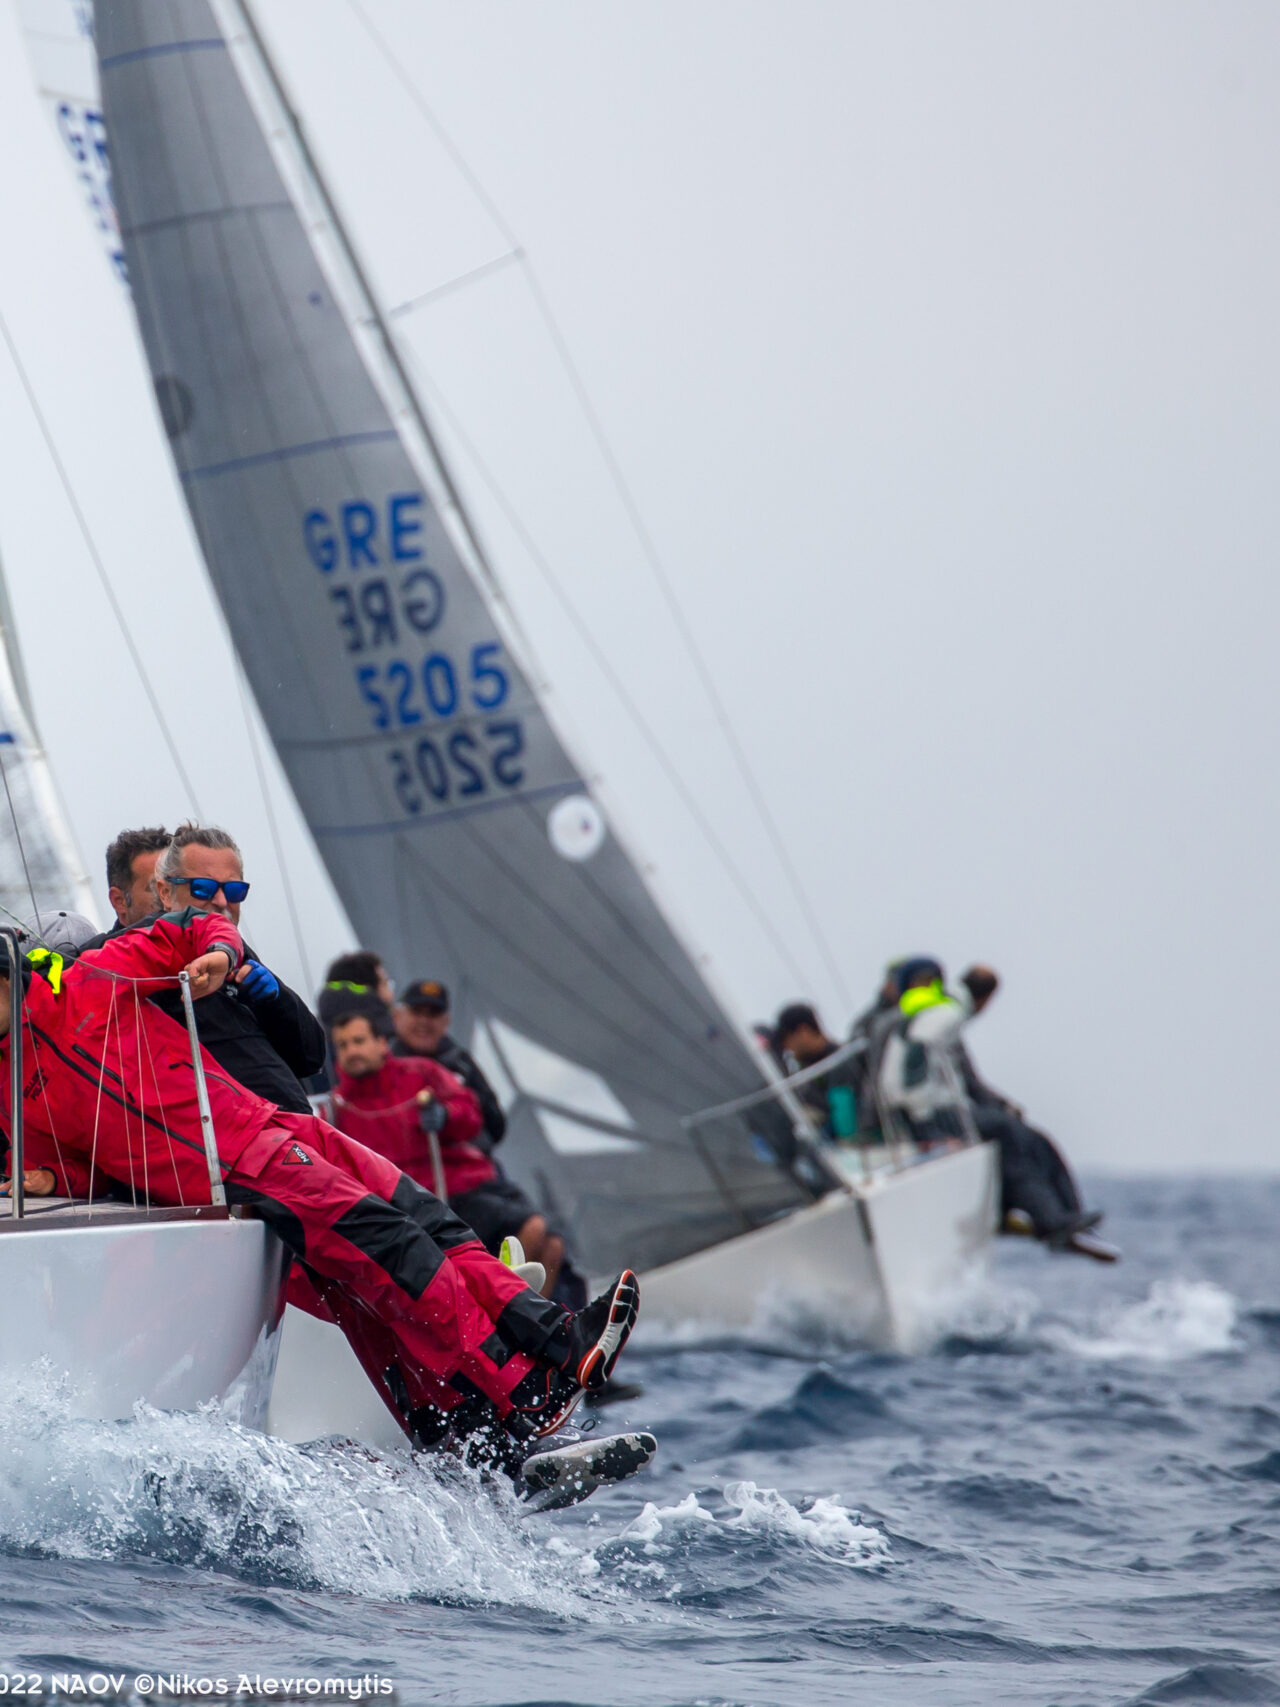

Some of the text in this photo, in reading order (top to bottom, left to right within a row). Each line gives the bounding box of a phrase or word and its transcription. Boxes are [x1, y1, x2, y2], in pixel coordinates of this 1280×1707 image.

[303, 491, 427, 574] GRE
[355, 642, 511, 731] 5205
[292, 1146, 310, 1163] MPX
